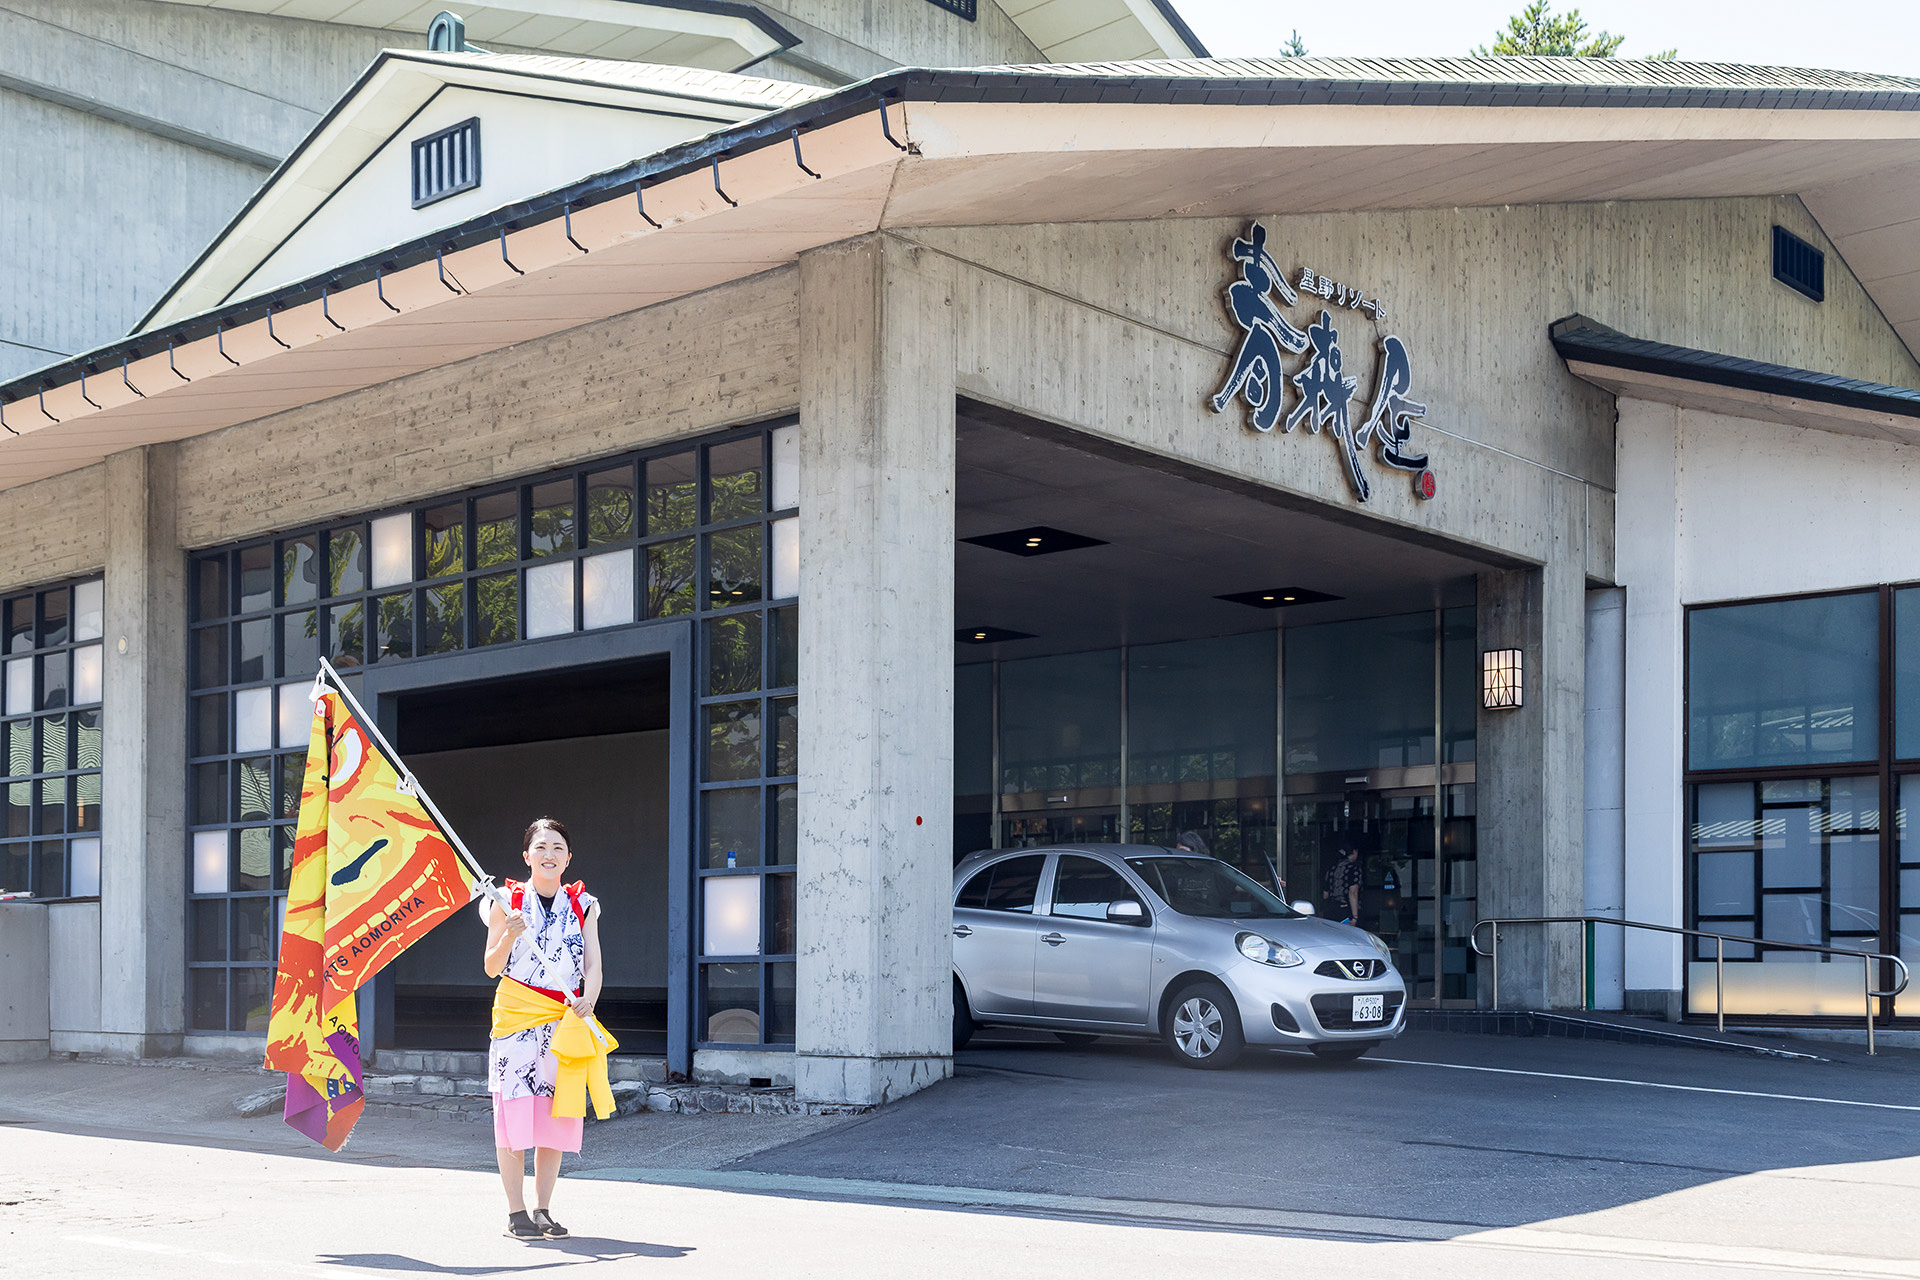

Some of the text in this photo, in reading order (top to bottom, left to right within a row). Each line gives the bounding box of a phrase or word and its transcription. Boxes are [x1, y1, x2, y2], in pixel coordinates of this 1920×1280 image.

[322, 896, 425, 985] RTS AOMORIYA
[329, 1015, 361, 1060] AOMO
